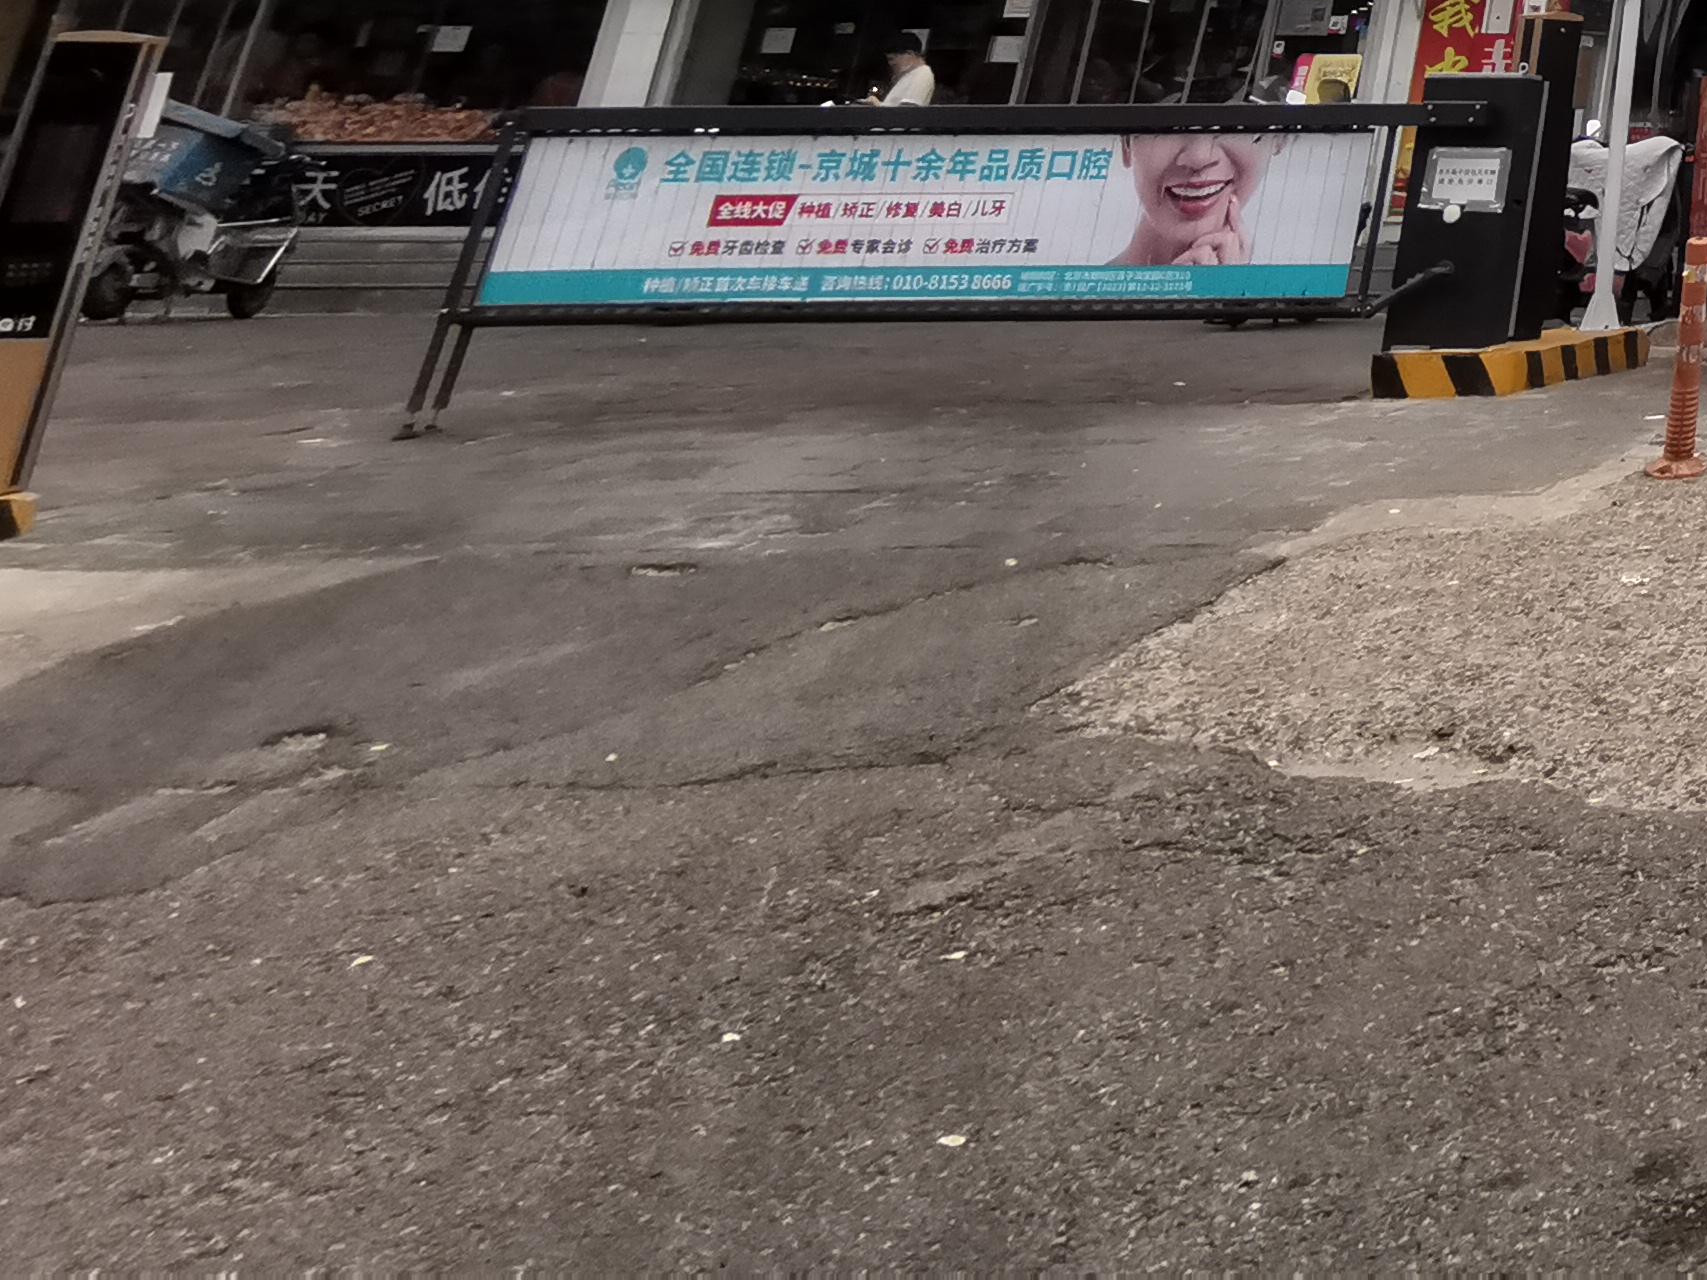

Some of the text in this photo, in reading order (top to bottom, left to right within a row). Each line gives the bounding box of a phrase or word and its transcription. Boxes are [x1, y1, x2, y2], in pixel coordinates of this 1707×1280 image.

[659, 148, 1113, 184] 全国连锁-京城十余年品质口腔
[715, 201, 787, 221] 全线大促
